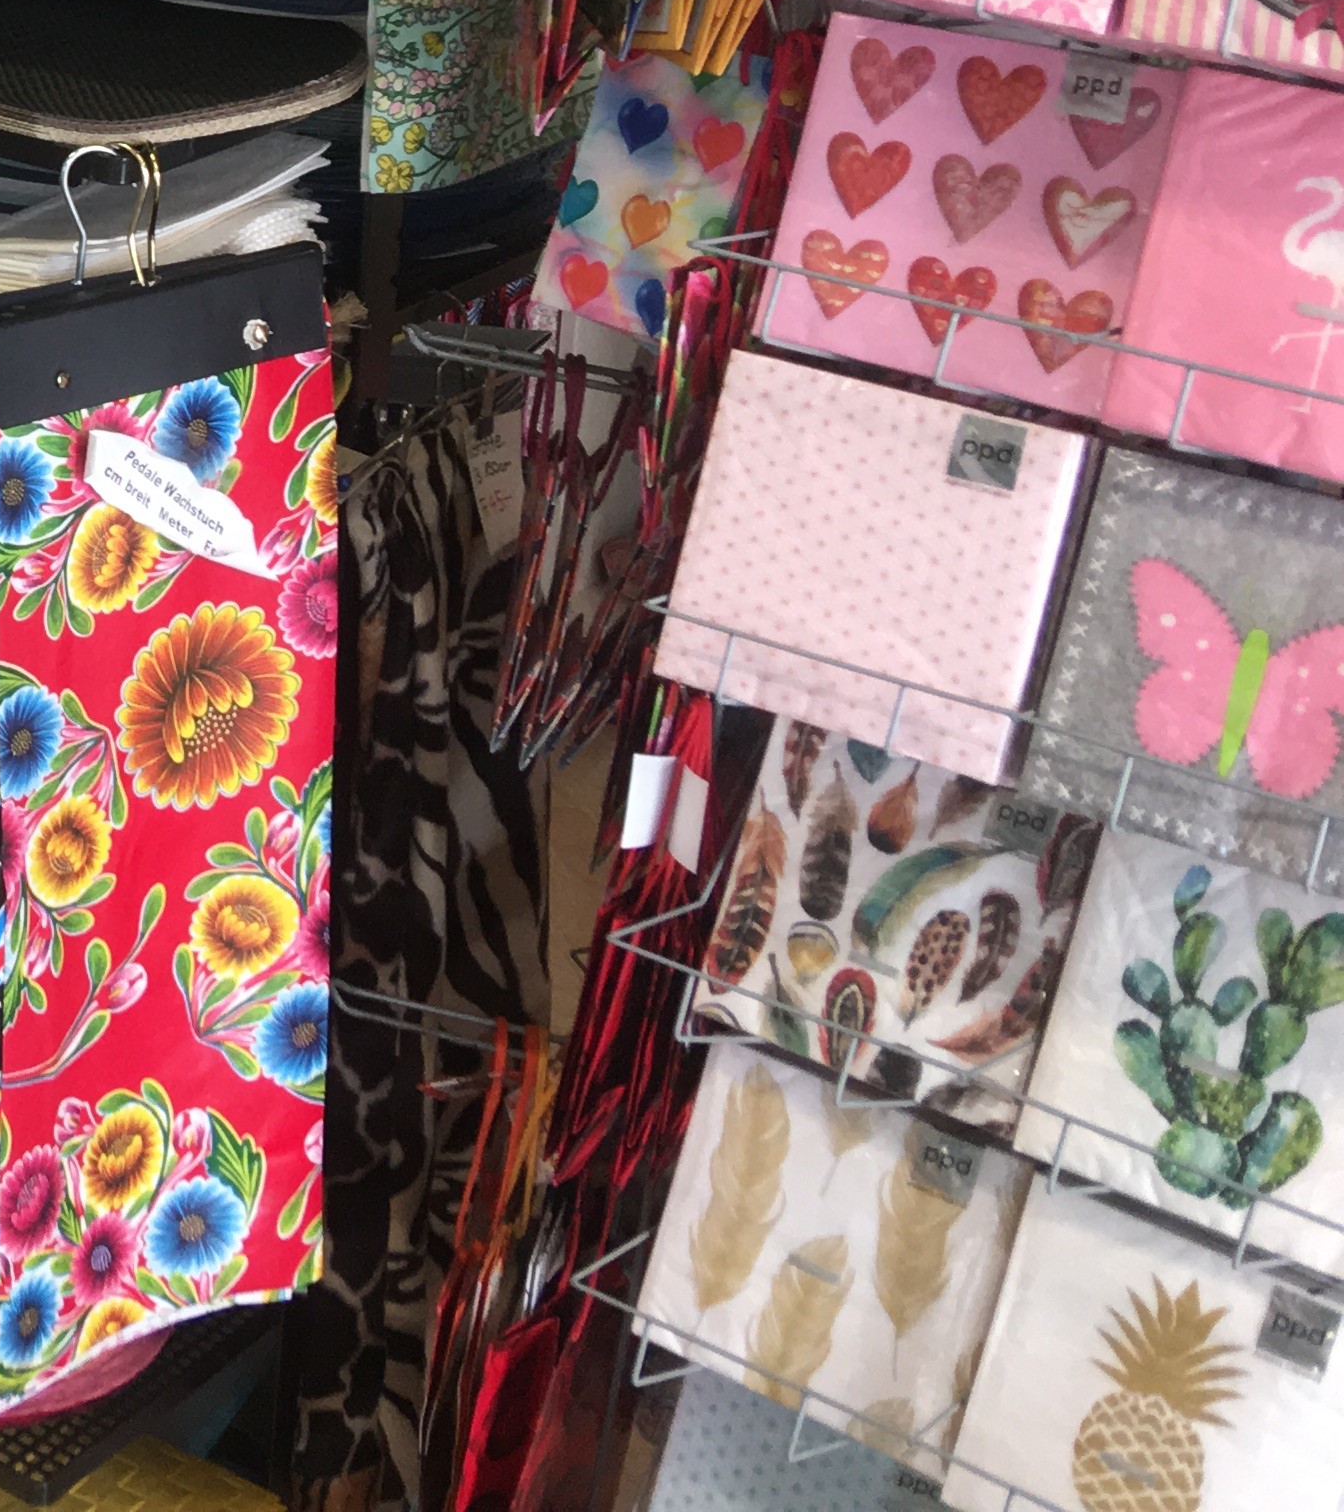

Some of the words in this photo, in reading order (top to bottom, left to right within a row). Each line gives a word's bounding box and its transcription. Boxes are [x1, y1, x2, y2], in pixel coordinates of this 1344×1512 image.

[1072, 74, 1123, 97] ppd
[959, 439, 1015, 464] ppd
[103, 466, 124, 487] cm
[124, 479, 152, 510] breit
[158, 506, 195, 540] Meter
[124, 449, 163, 488] Pedale
[163, 481, 225, 536] Wachstuch
[997, 803, 1048, 833] ppd
[922, 1144, 973, 1177] ppd
